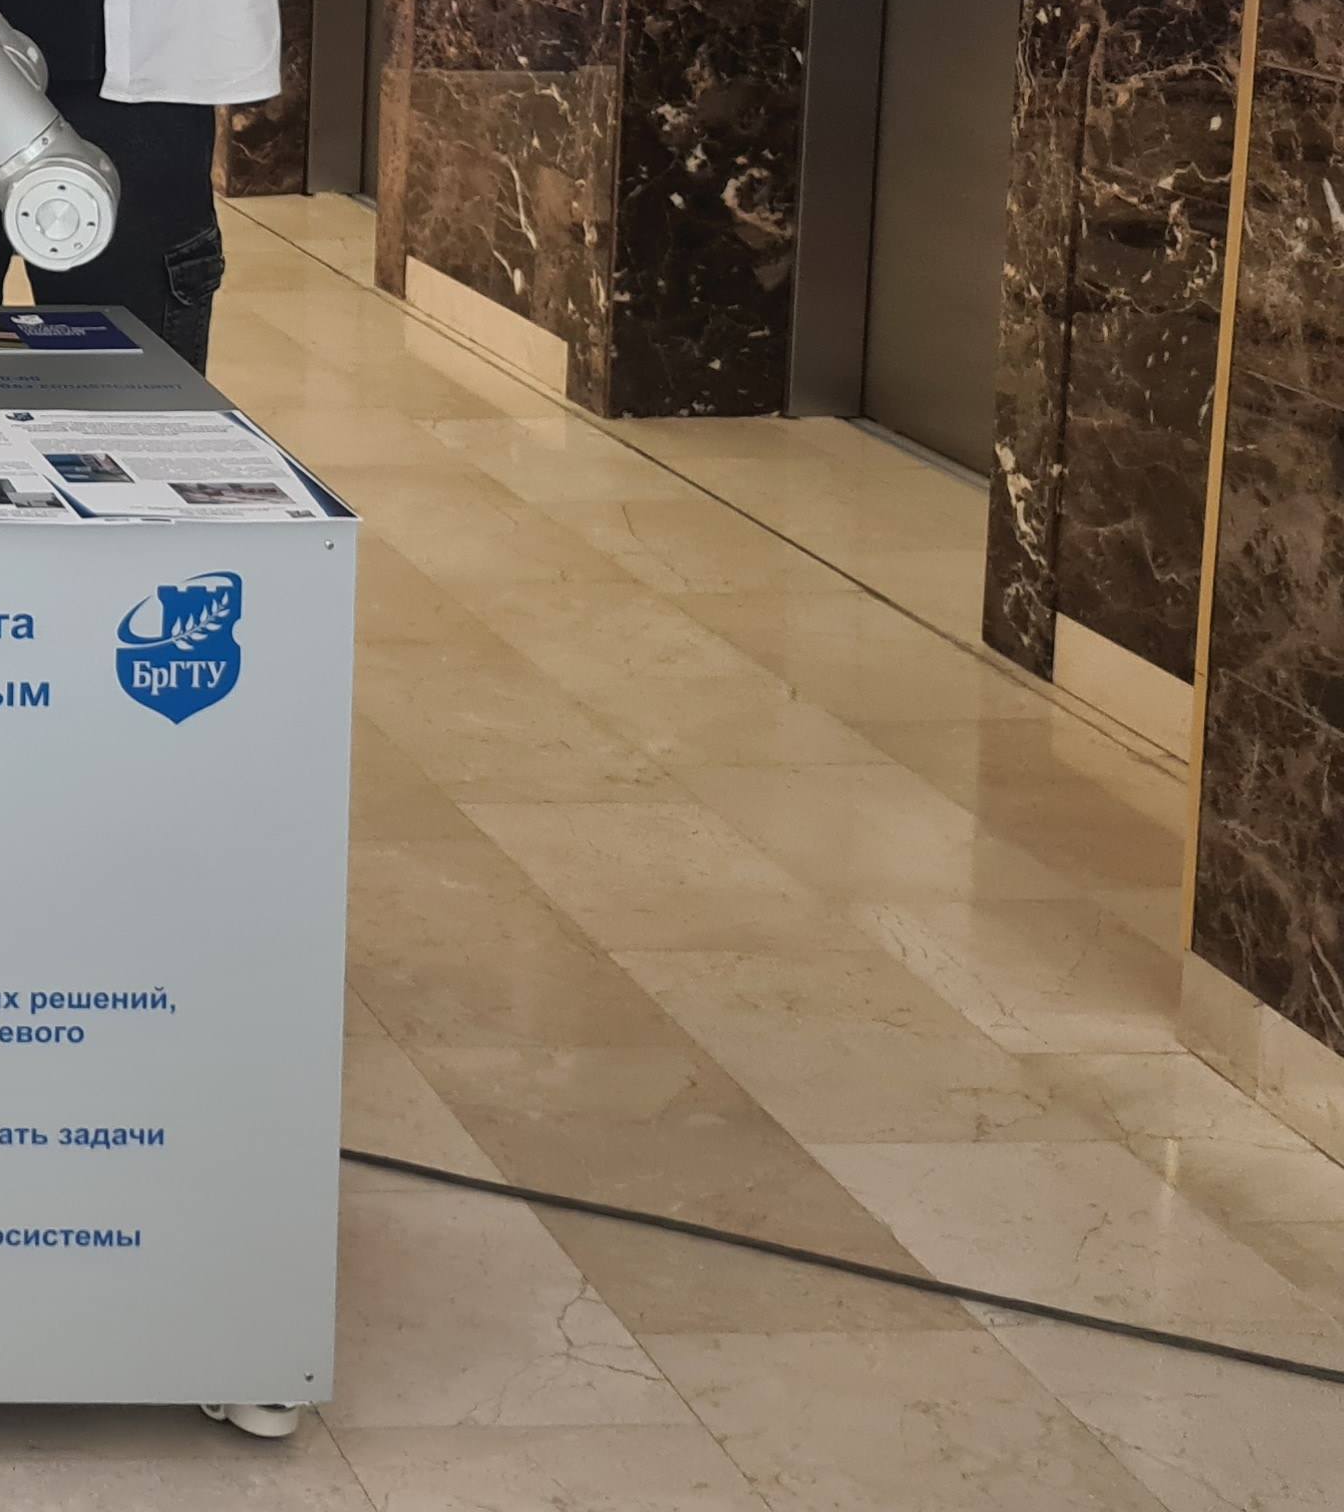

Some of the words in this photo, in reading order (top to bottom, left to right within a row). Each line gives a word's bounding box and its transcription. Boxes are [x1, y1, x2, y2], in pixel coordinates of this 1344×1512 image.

[132, 660, 227, 696] БрГТУ
[29, 987, 176, 1015] решений,
[62, 1128, 166, 1149] задачи
